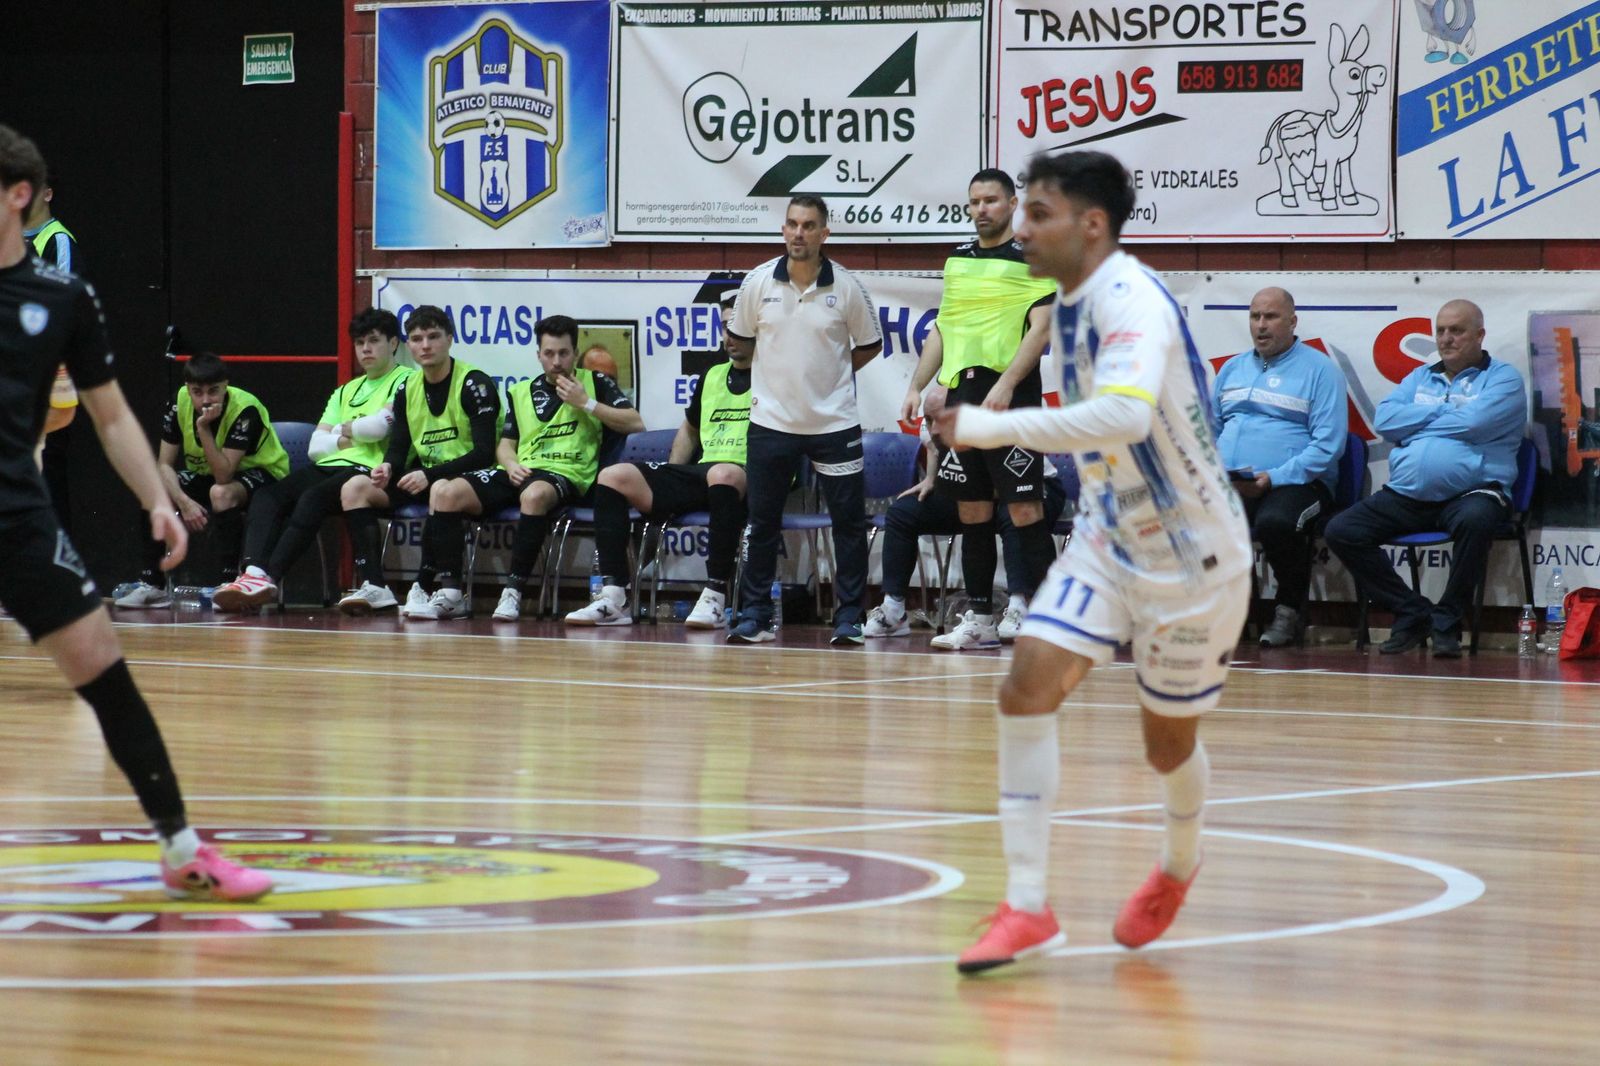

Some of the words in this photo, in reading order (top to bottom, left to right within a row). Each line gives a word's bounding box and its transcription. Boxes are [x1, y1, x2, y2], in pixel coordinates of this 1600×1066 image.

[625, 8, 696, 23] EXCAVACIONES
[704, 7, 764, 23] MOVIMIENTO
[766, 7, 778, 22] DE
[780, 6, 821, 22] TIERRAS
[831, 6, 867, 21] PLANTA
[869, 5, 881, 20] DE
[882, 2, 936, 20] HORMIGÓN
[937, 4, 945, 18] Y
[946, 2, 982, 18] ÁRIDOS
[1014, 0, 1307, 42] TRANSPORTES
[250, 43, 276, 58] SALIDA
[278, 42, 287, 56] DE
[246, 60, 292, 76] EMERGENCIA
[482, 63, 507, 75] CLUB
[1180, 65, 1216, 90] 658
[1223, 65, 1259, 89] 913
[1266, 63, 1302, 88] 682
[437, 96, 486, 120] ATLETICO
[491, 94, 553, 118] BENAVENTE
[1017, 66, 1157, 139] JESUS
[693, 94, 916, 156] Gejotrans
[836, 159, 876, 183] S.L.
[1151, 169, 1239, 189] VIDRIALES
[1438, 130, 1536, 230] LA
[844, 204, 883, 224] 666
[890, 204, 930, 224] 416
[1532, 543, 1600, 567] BANC
[1055, 575, 1096, 619] 11
